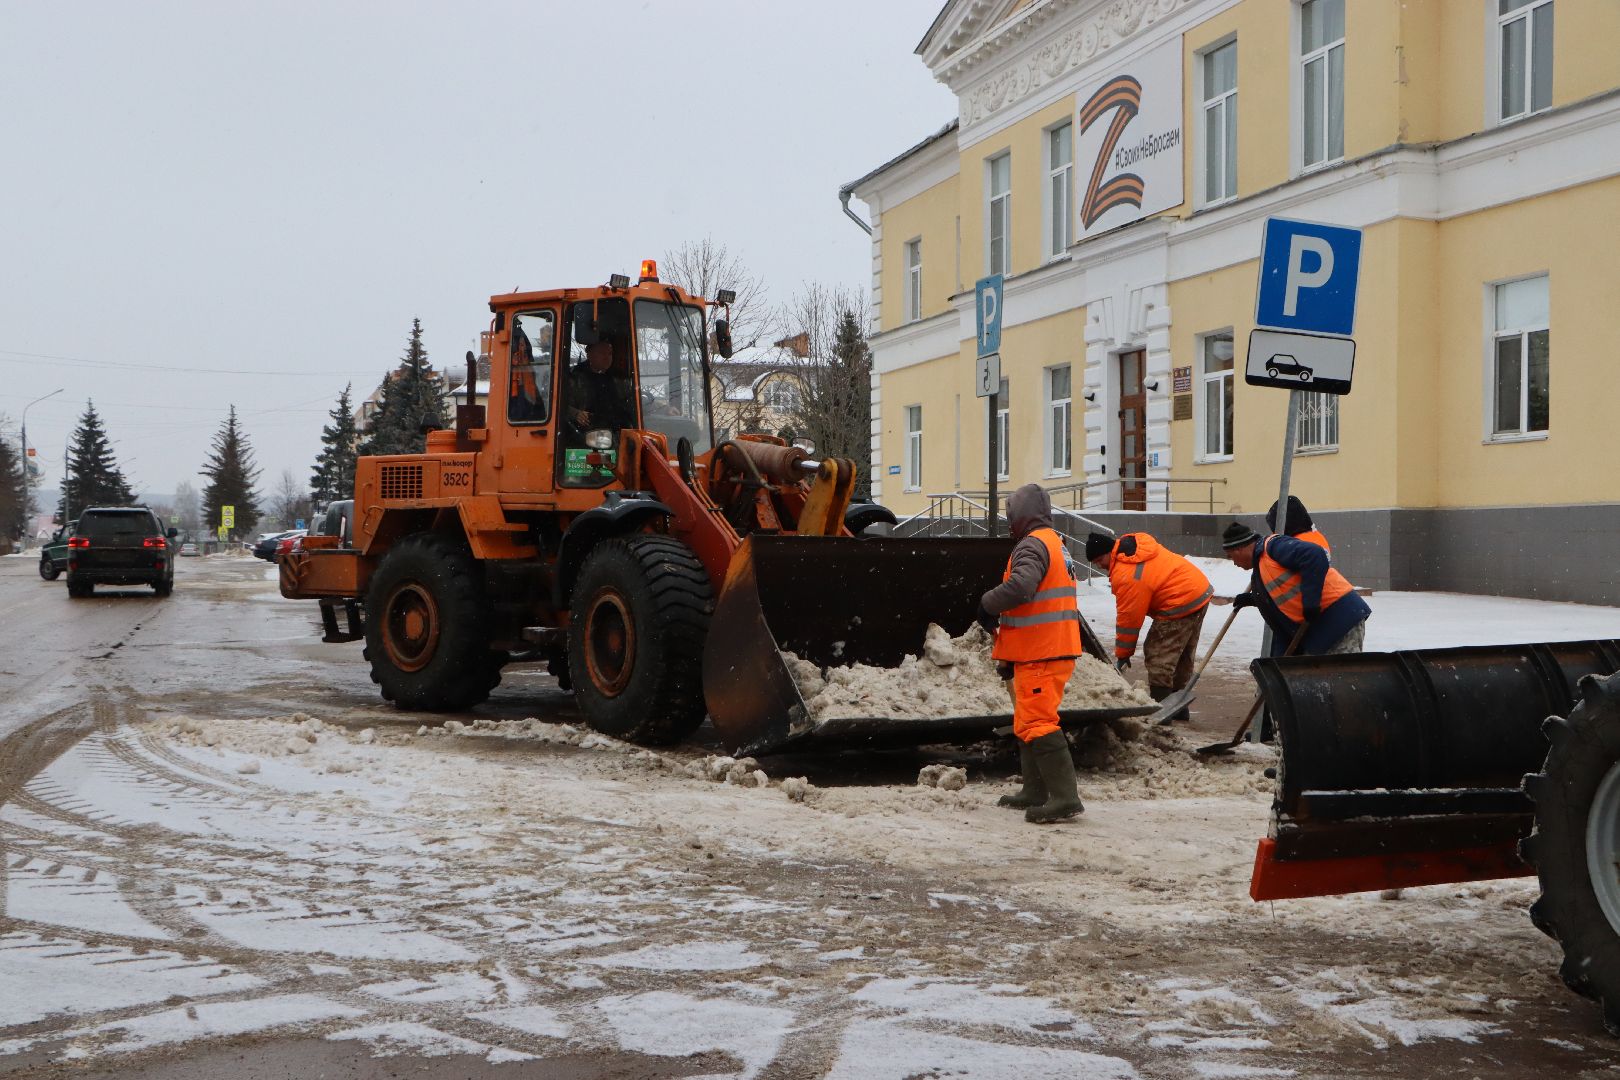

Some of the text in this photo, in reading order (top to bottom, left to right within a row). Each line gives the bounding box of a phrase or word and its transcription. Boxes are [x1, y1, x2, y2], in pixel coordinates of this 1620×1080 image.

[1080, 74, 1145, 231] Z
[1115, 128, 1180, 171] #СвоихНеБросаем
[1283, 234, 1335, 316] P
[983, 287, 997, 346] P
[443, 472, 469, 487] 352C
